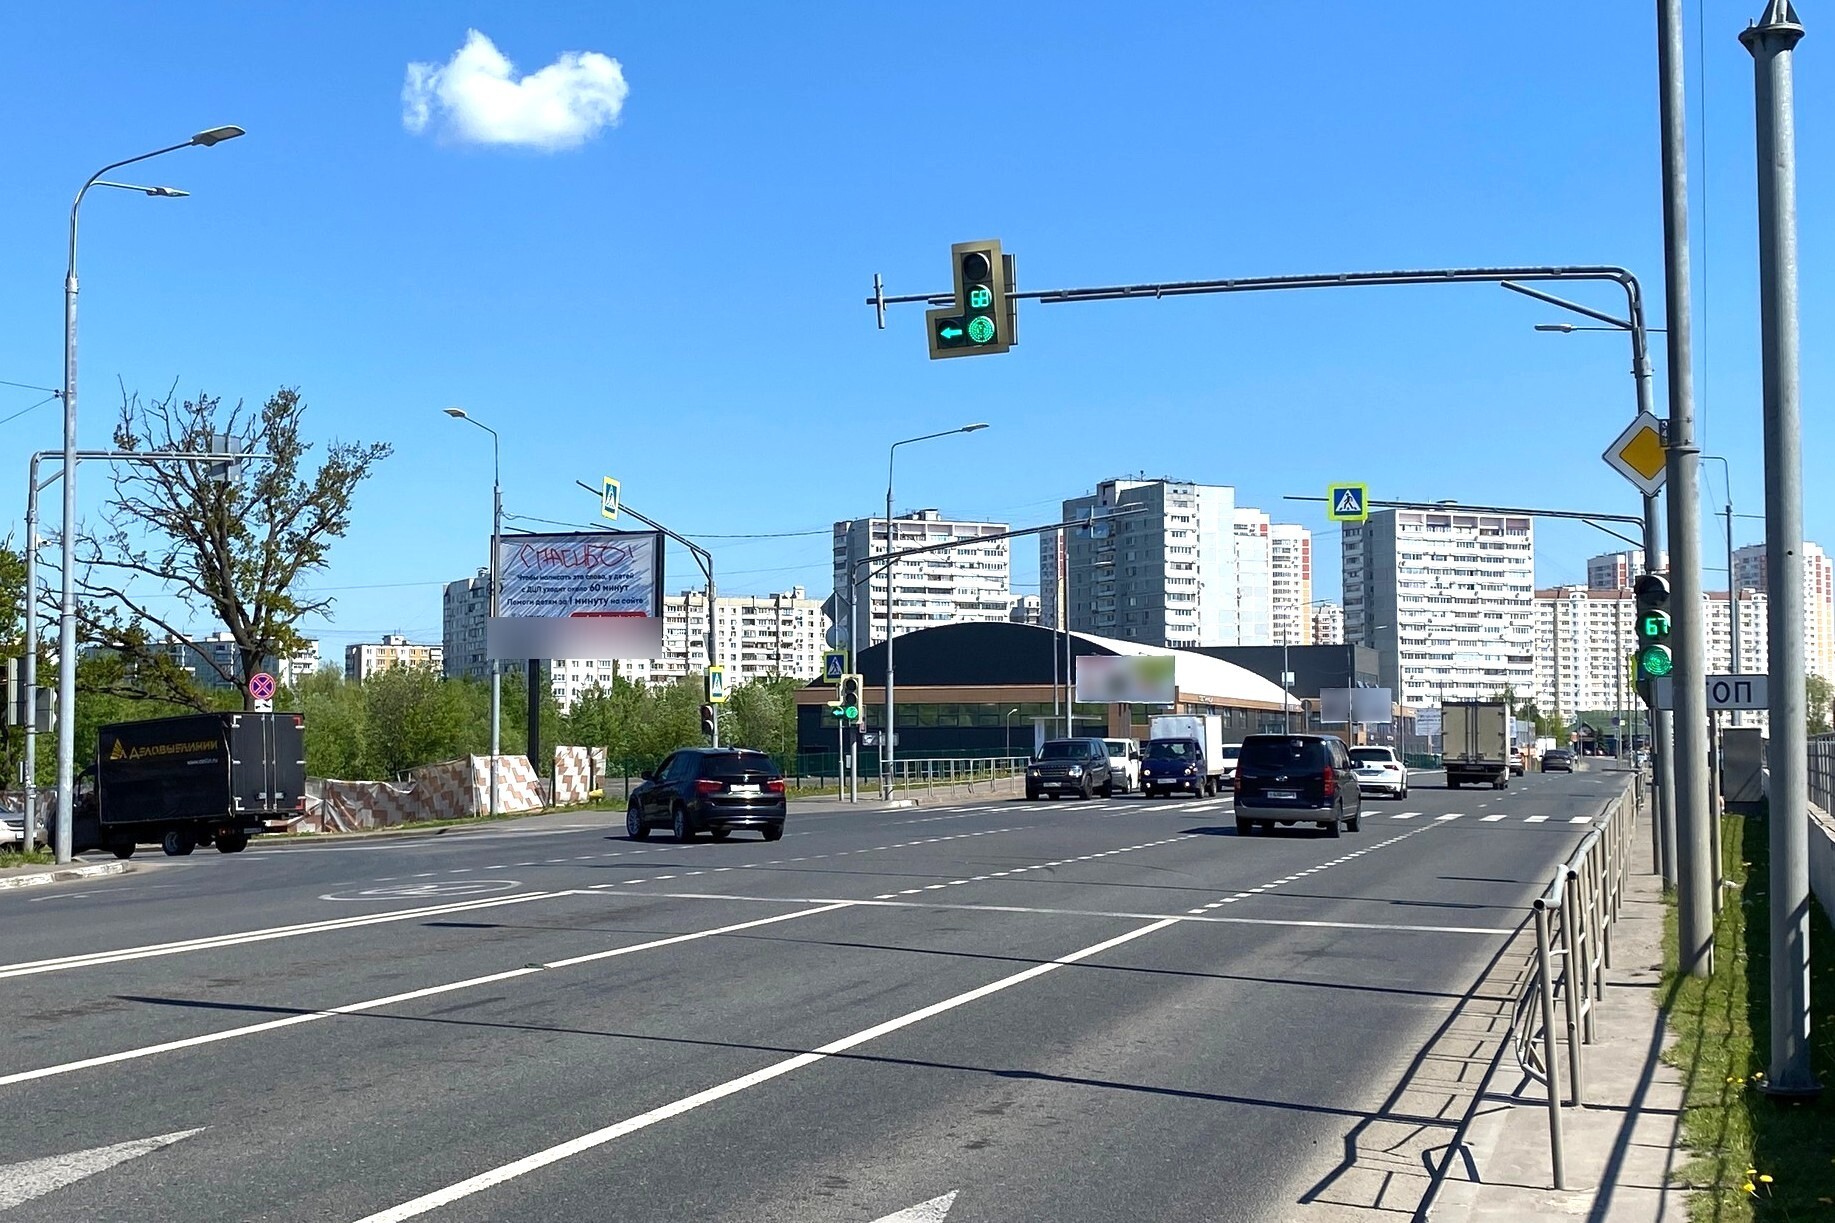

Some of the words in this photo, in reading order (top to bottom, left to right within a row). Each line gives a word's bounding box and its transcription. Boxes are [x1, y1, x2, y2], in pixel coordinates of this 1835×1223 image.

[517, 573, 539, 581] Чтобы
[614, 572, 635, 580] детей
[527, 585, 542, 593] ДЦП
[543, 586, 566, 594] уходит
[590, 583, 600, 592] 60
[603, 584, 629, 593] минут
[507, 598, 534, 606] Помоги
[536, 598, 557, 606] детям
[575, 597, 609, 607] минуту
[621, 596, 644, 604] сайте
[1706, 680, 1752, 704] ОП
